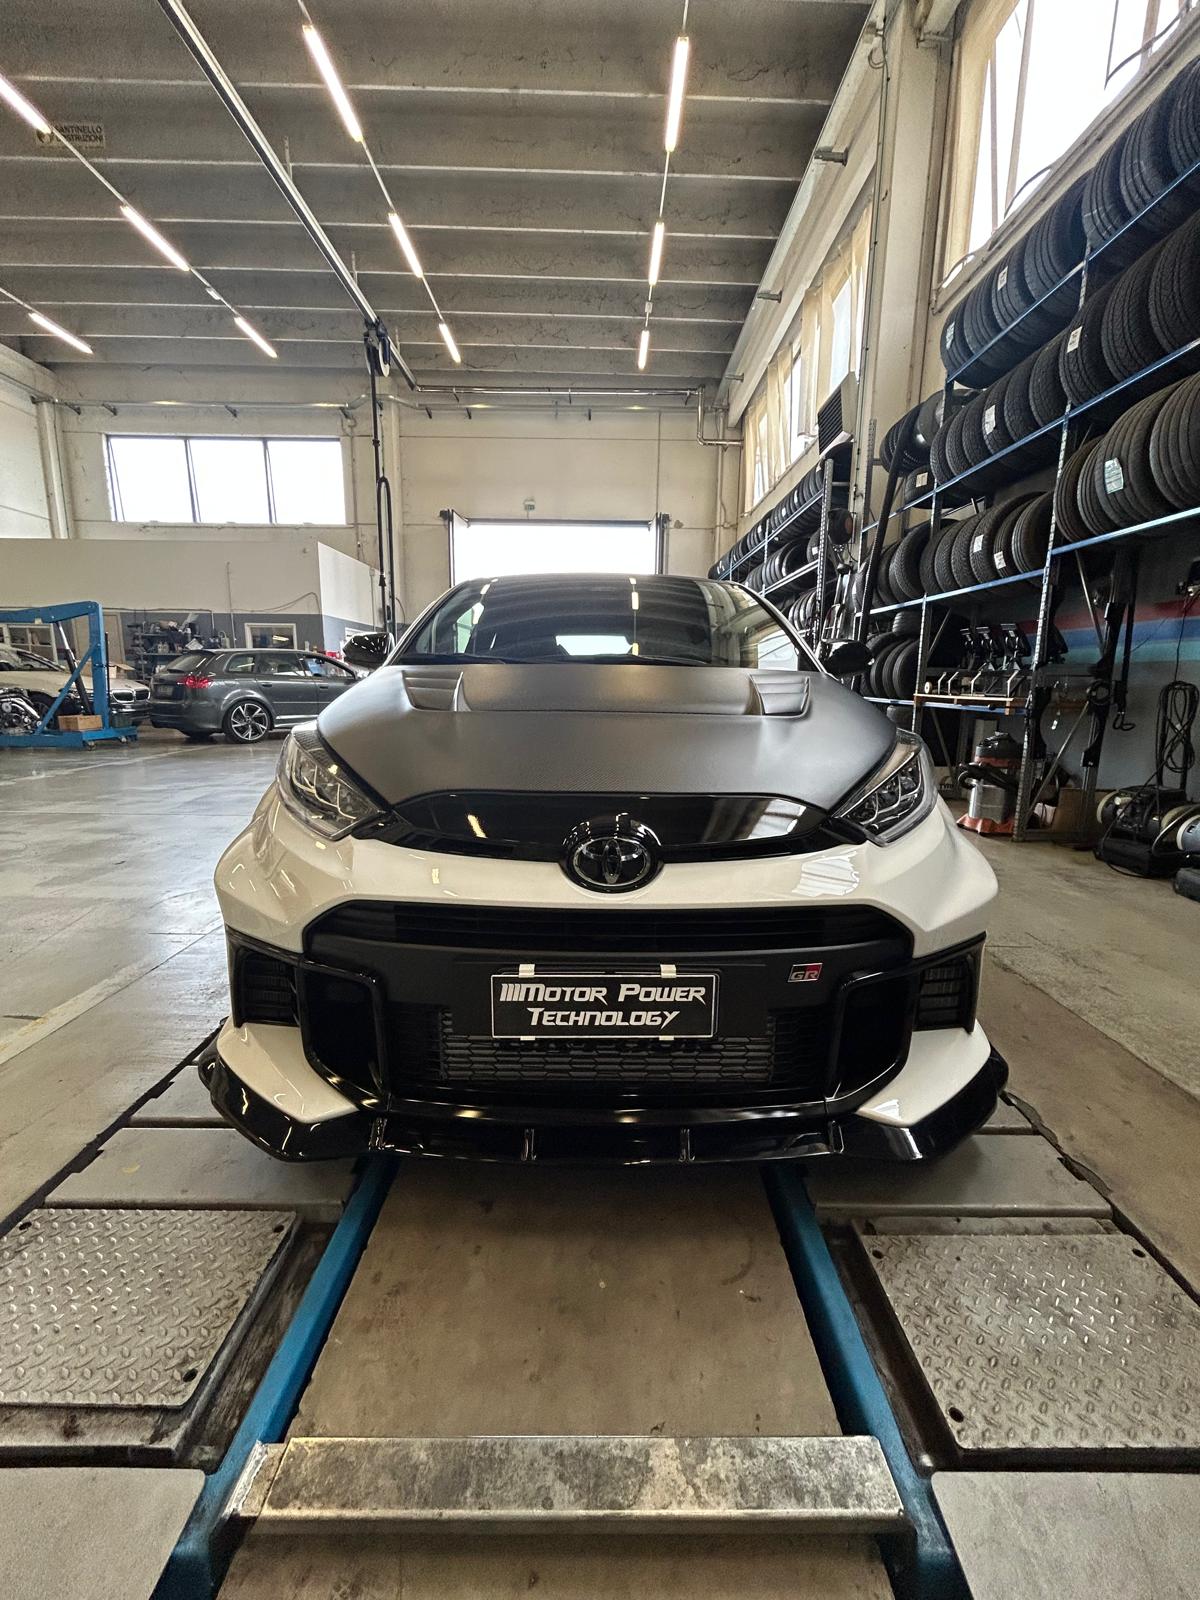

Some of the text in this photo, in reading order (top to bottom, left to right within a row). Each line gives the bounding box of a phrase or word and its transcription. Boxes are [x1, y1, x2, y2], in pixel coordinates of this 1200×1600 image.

[790, 970, 819, 980] GR
[618, 983, 706, 1006] POWER
[526, 1007, 681, 1030] TECHNOLOGY
